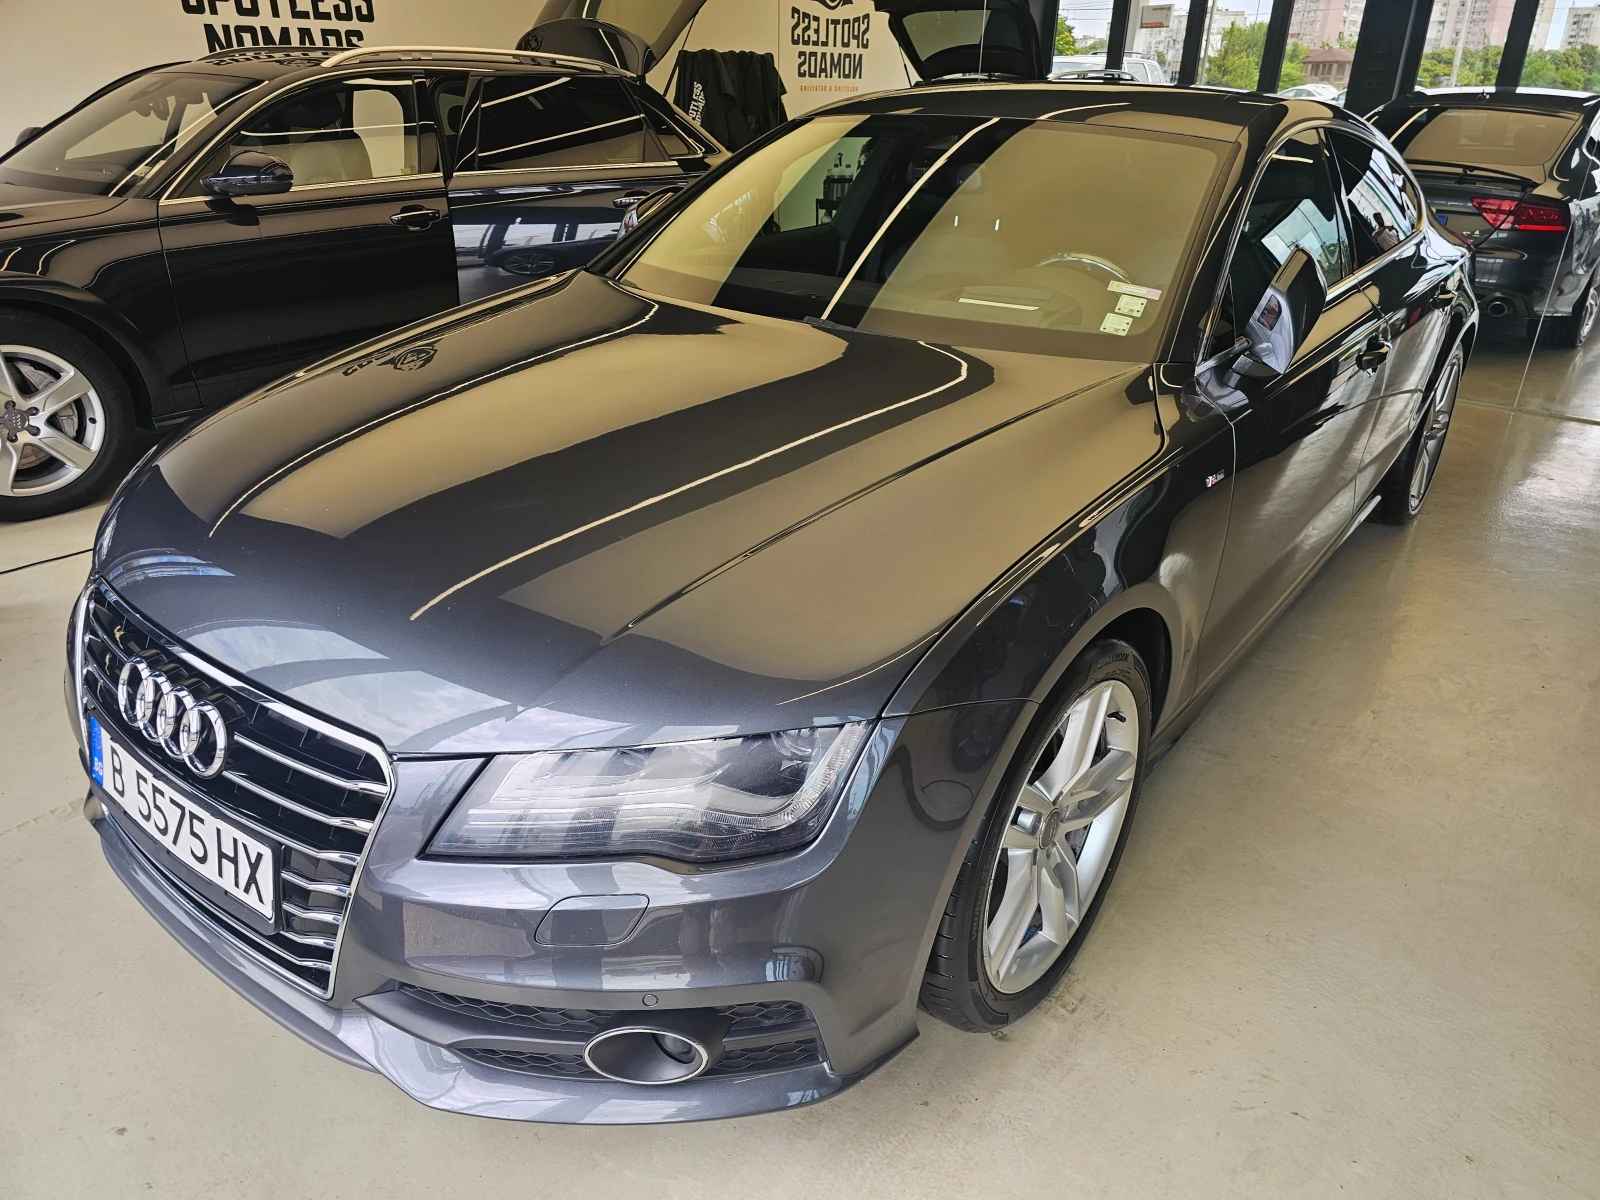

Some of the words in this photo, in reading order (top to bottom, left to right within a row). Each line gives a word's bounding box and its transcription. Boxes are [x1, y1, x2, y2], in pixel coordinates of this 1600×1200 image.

[689, 81, 703, 118] OTLESS
[94, 756, 103, 776] BG
[110, 744, 125, 798] B
[136, 769, 208, 865] 5575
[216, 827, 265, 905] HX
